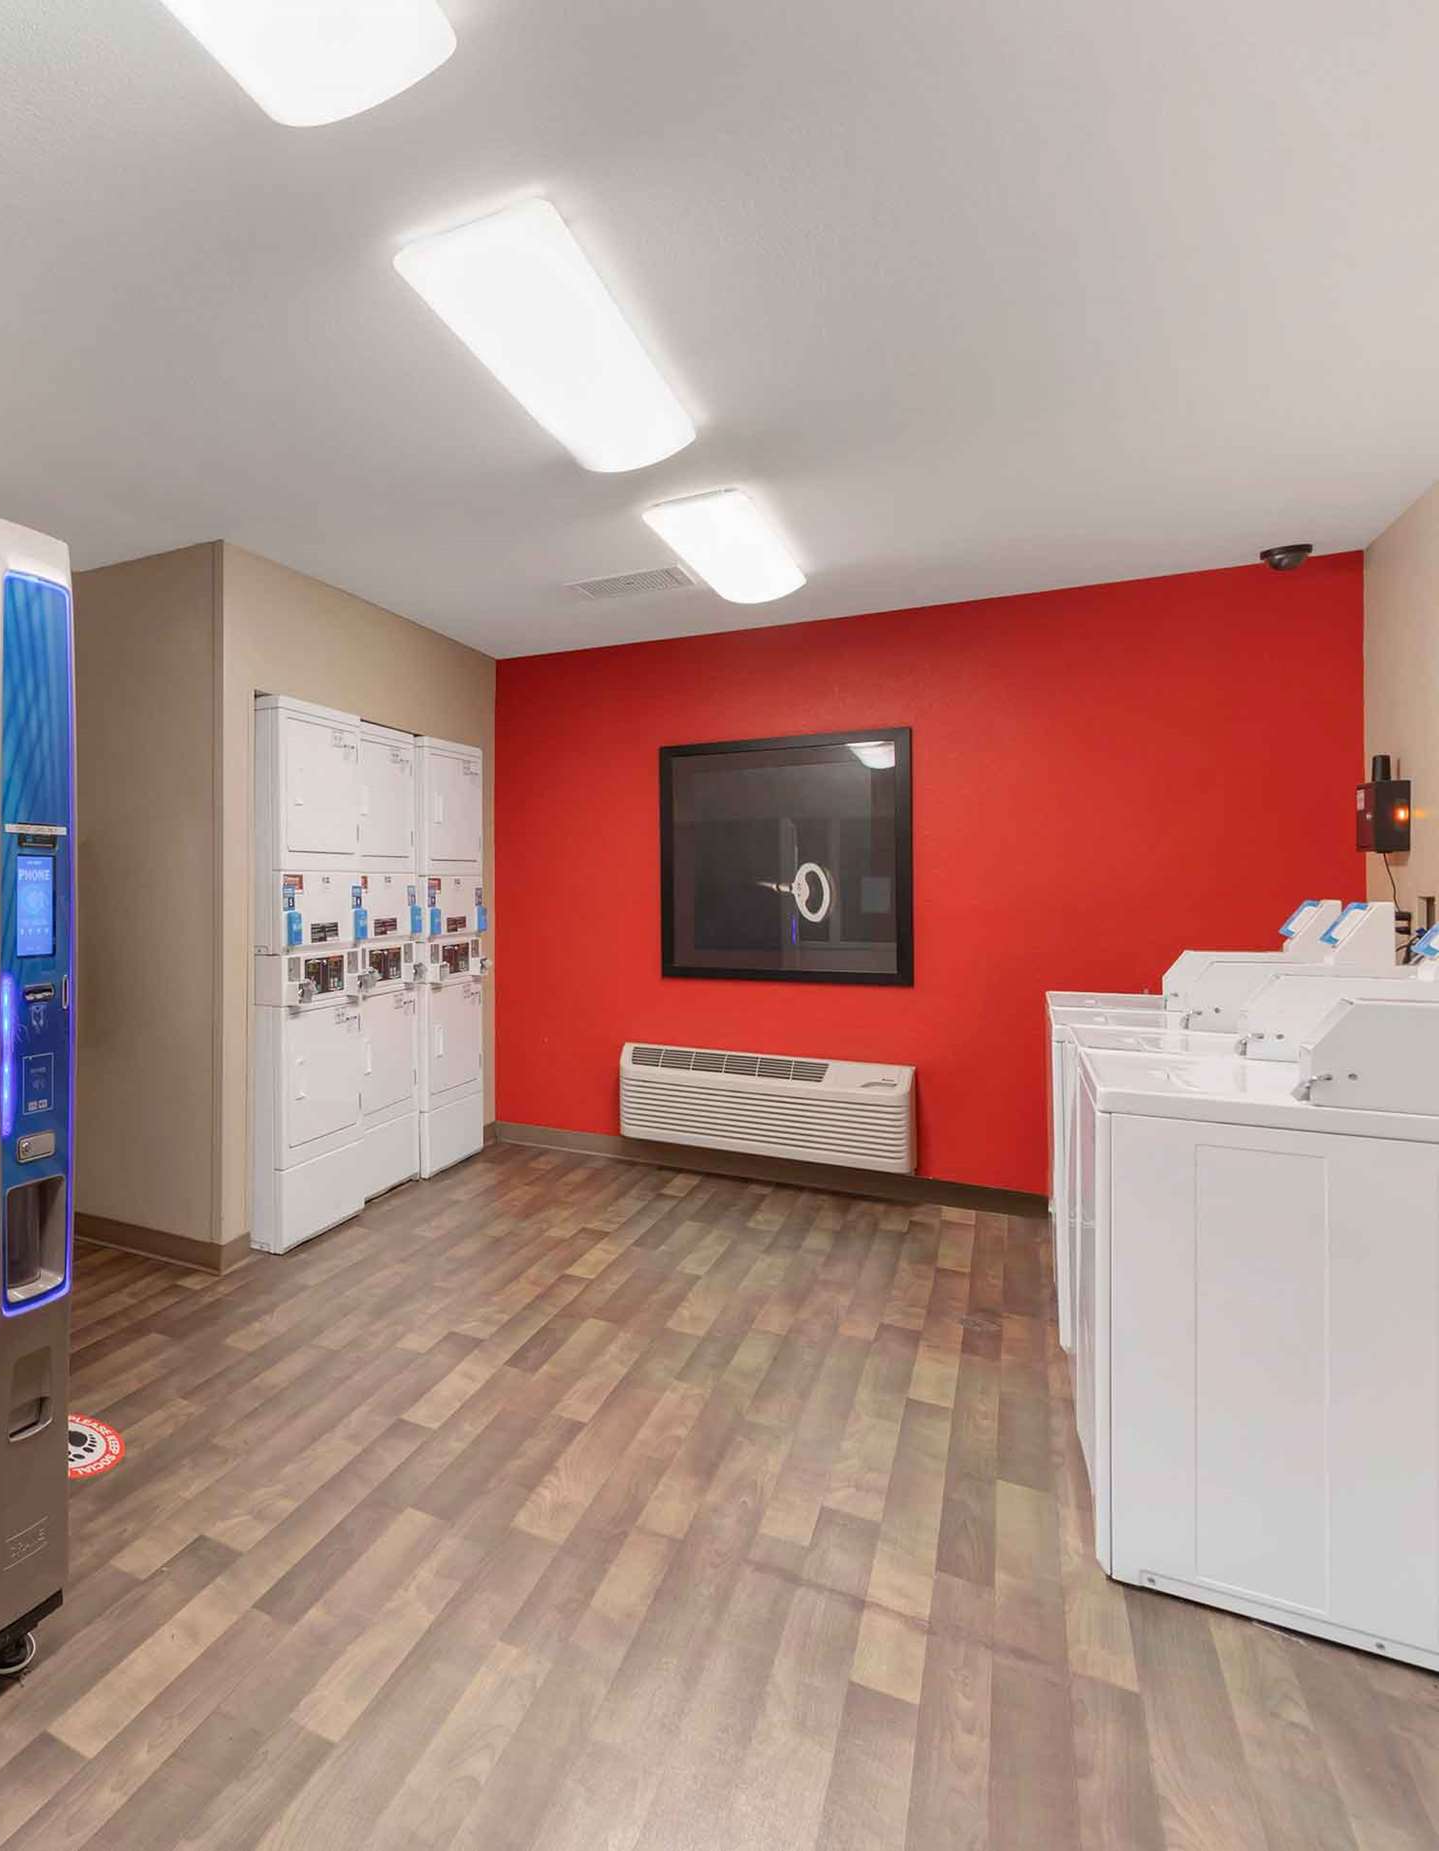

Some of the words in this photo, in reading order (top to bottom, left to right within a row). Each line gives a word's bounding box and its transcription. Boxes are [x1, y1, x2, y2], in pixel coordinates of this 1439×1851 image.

[18, 869, 50, 881] PHONE
[69, 1416, 112, 1435] PLEASE
[78, 1454, 116, 1475] SOCIAL
